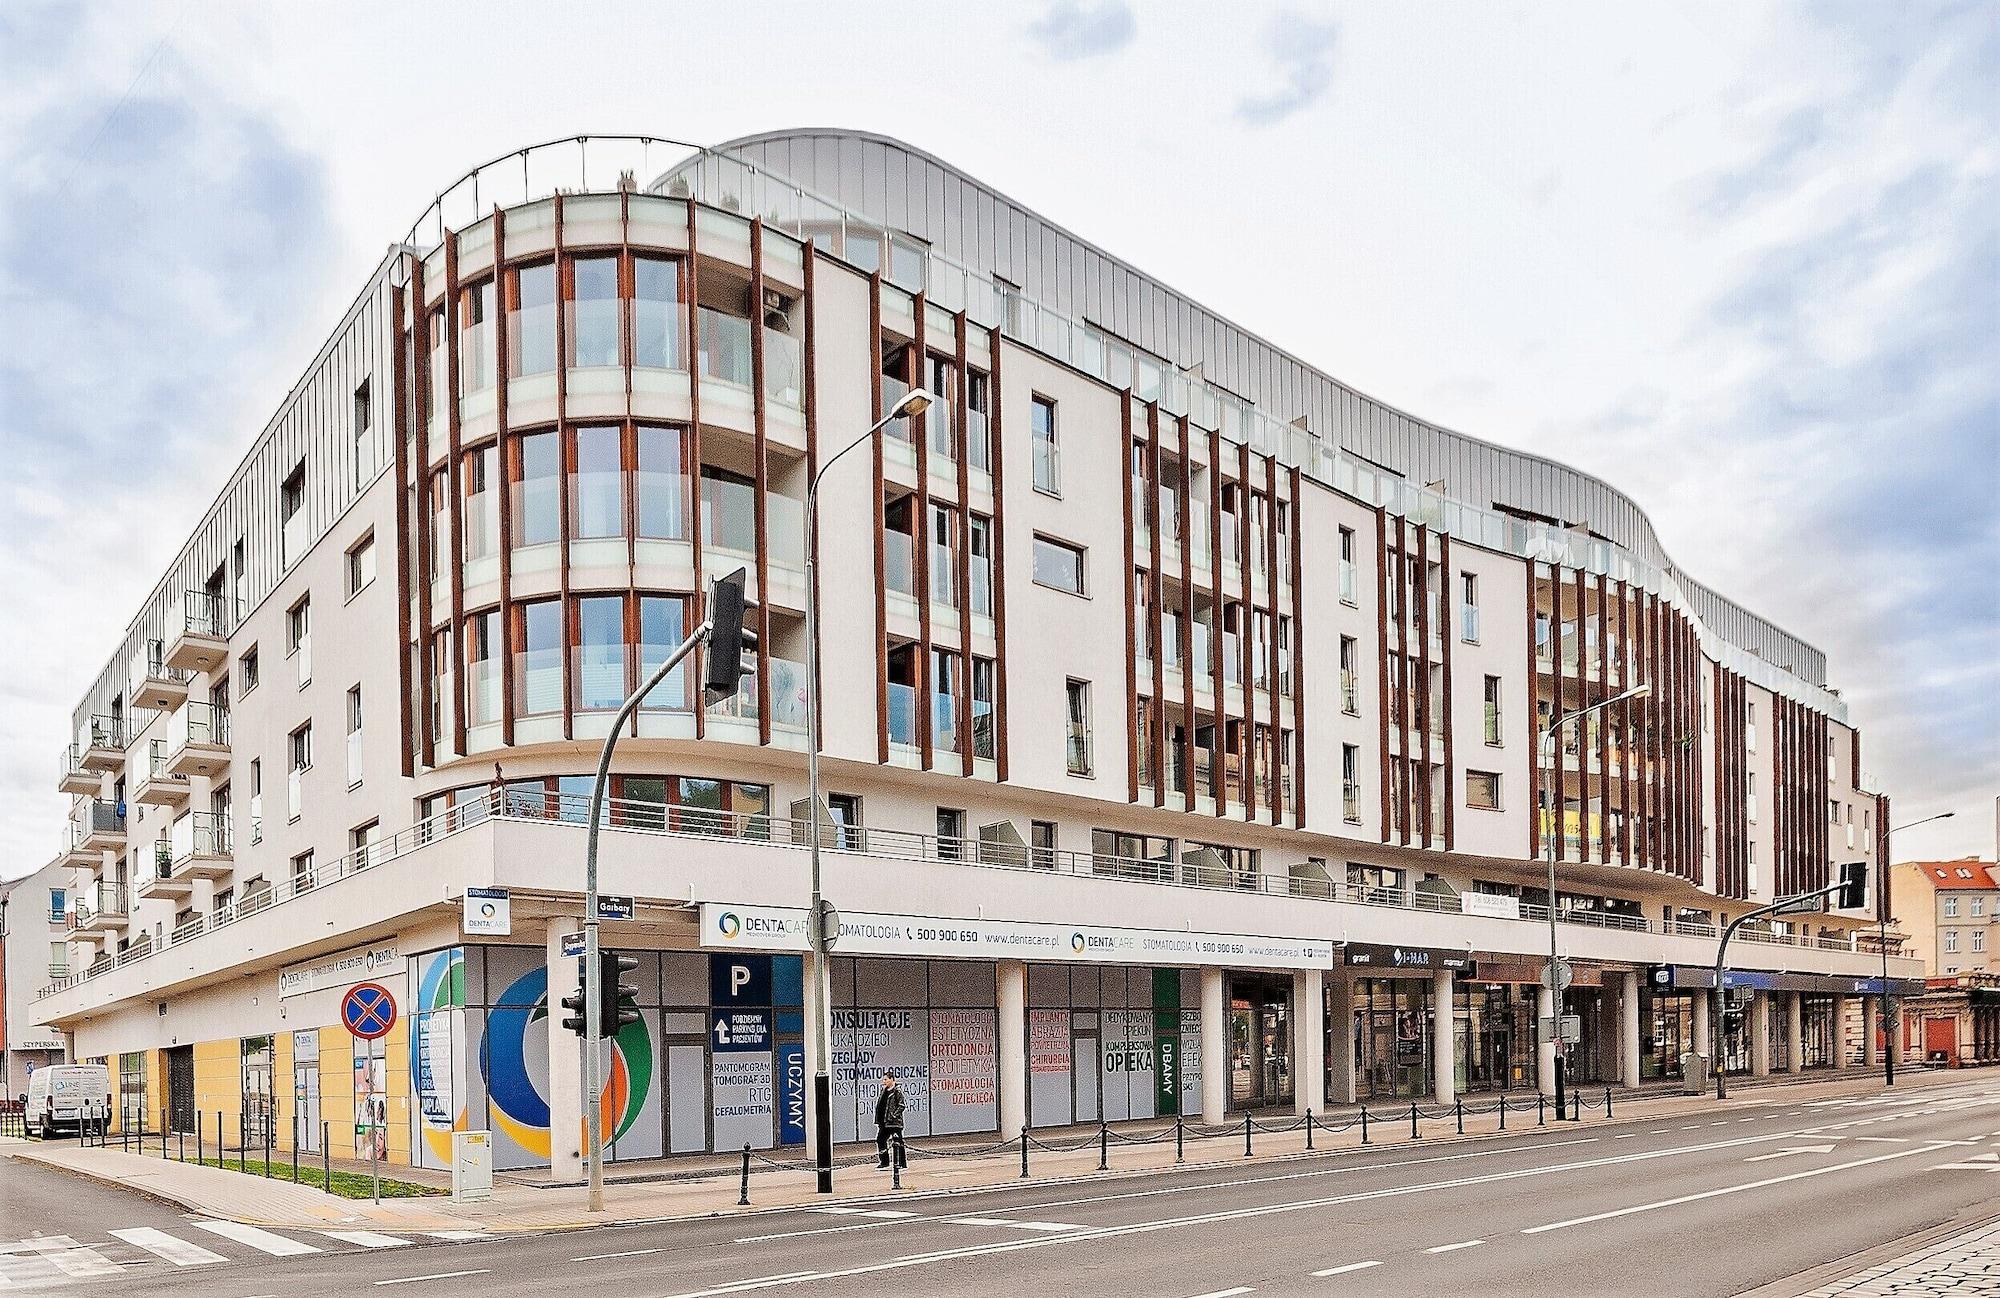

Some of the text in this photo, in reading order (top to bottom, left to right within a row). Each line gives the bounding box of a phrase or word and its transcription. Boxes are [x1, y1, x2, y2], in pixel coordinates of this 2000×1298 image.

[599, 902, 631, 914] Garbary
[469, 920, 507, 928] DENTACARE
[746, 917, 1060, 949] DENTACAR OMATOLOGIA 500 900 650 www.dentacare.pl
[1088, 936, 1134, 949] DENTACARE
[1142, 938, 1192, 952] STOMATOLOGIA
[1202, 942, 1216, 954] 500
[1217, 942, 1231, 954] 900
[1232, 943, 1244, 955] 650
[731, 965, 751, 996] P
[831, 1011, 911, 1029] ONSULTACJE
[931, 1011, 994, 1024] STOMATOLOGIA
[1105, 1011, 1153, 1023] DEDYKOWANY
[732, 1024, 768, 1034] PARKING DLA
[931, 1026, 994, 1041] ESTETYCZNA
[732, 1033, 763, 1044] PACJENTÓW
[858, 1033, 890, 1047] DZIECI
[931, 1043, 994, 1057] ORTODONCJA
[832, 1051, 876, 1066] ZEGLĄDY
[1031, 1053, 1070, 1065] CHIRURGIA
[1106, 1051, 1154, 1072] OPIEKA
[714, 1062, 771, 1073] PANTOMOGRAM
[931, 1058, 995, 1074] PROTETYKA
[1162, 1043, 1173, 1095] DBAMY
[714, 1075, 771, 1086] TOMOGRAF 3D
[931, 1078, 995, 1090] STOMATOLOGIA
[749, 1087, 772, 1102] RTG
[787, 1053, 804, 1129] UCZYMY
[952, 1092, 995, 1106] DZIECIĘCA
[715, 1104, 772, 1117] CEFALOMETRIA
